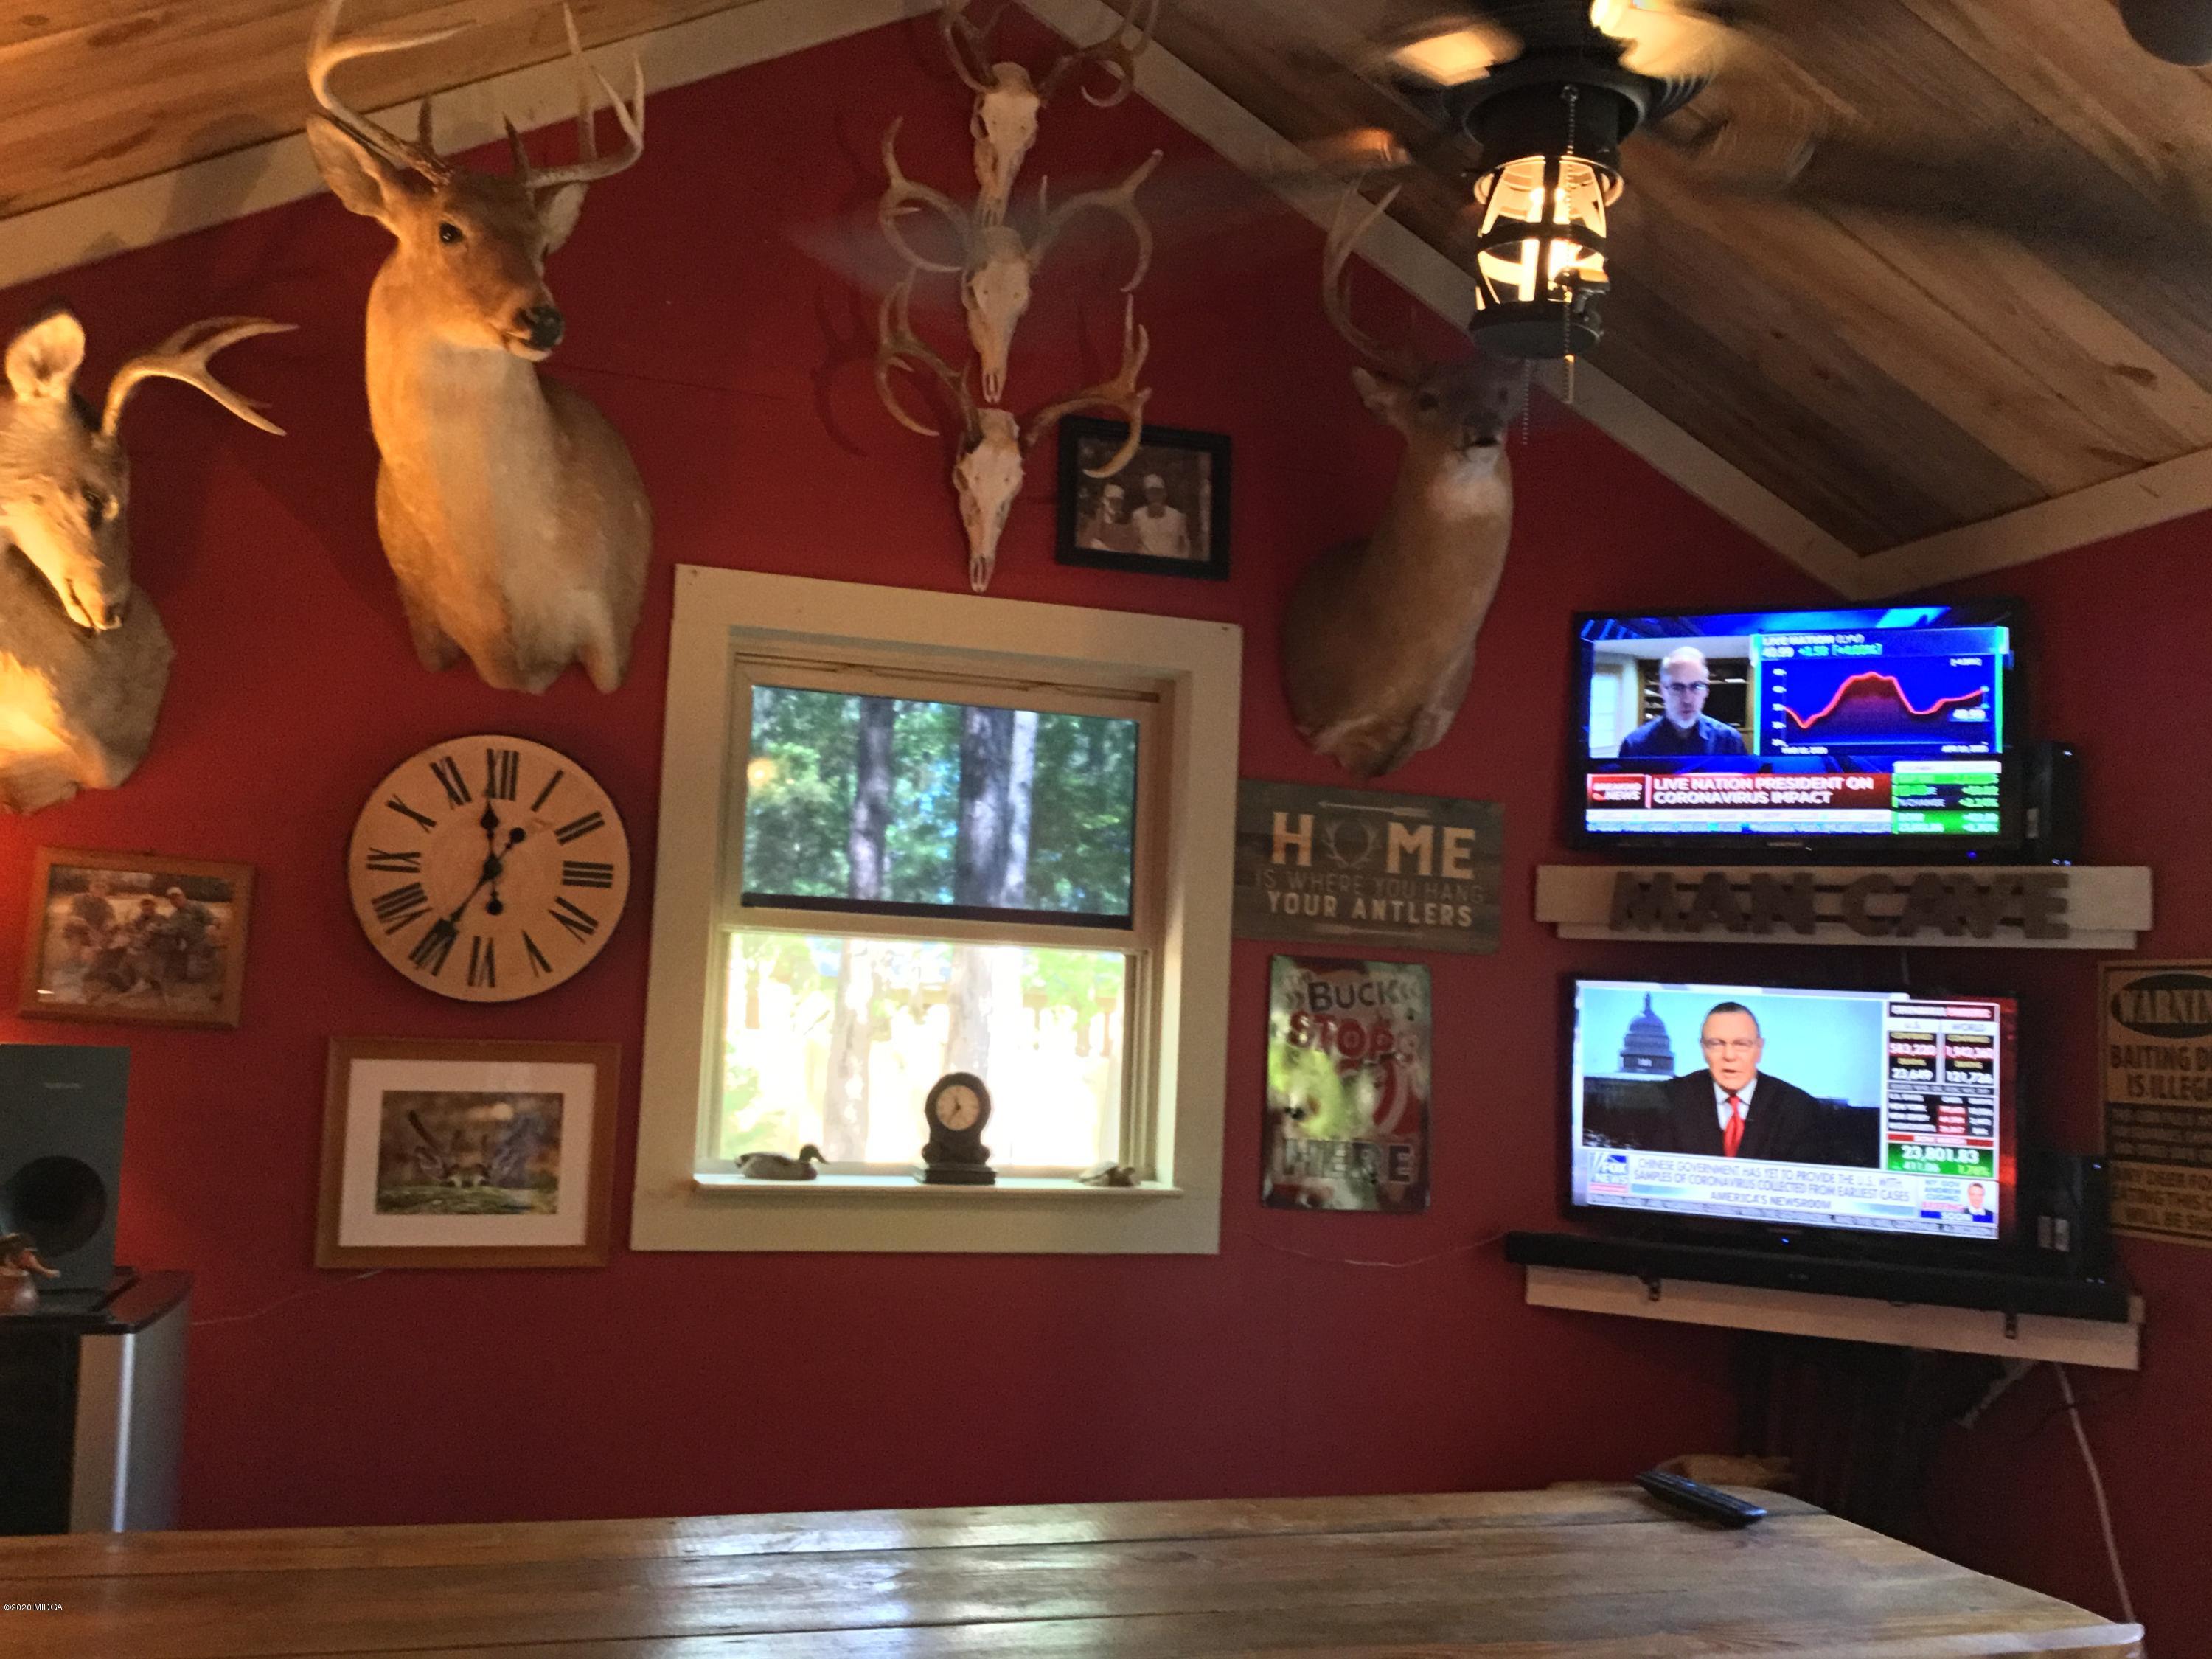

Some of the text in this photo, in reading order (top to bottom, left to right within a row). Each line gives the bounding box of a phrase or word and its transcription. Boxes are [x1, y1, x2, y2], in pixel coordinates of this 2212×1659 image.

[1653, 776, 1874, 790] LIVE NATION PRESIDENT ON
[1653, 791, 1834, 804] CORONAVIRUS IMPACT
[1256, 869, 1484, 904] IS WHERE YOU HANG
[1267, 891, 1473, 928] YOUR ANTLERS
[1608, 871, 2069, 939] MAN CAVE
[1307, 981, 1399, 1012] BUCK
[2110, 1045, 2192, 1071] BAITING
[2126, 1073, 2146, 1098] IS
[1900, 1145, 1980, 1164] 23,801.83
[1602, 1163, 1628, 1173] FOX
[1638, 1158, 1674, 1170] CHINESE
[1677, 1161, 1740, 1175] GOVERNMENT
[1743, 1167, 1761, 1178] HAS
[1764, 1169, 1778, 1179] YET
[1781, 1169, 1794, 1180] TO
[1796, 1170, 1834, 1183] PROVIDE
[1838, 1173, 1854, 1184] THE
[1633, 1170, 1910, 1202] SAMPLES OF CORONAVIRUS COLLECTED FROM EARLIEST CASES
[1710, 1191, 1767, 1205] AMERICA'S
[1769, 1197, 1832, 1210] NEWSROOM
